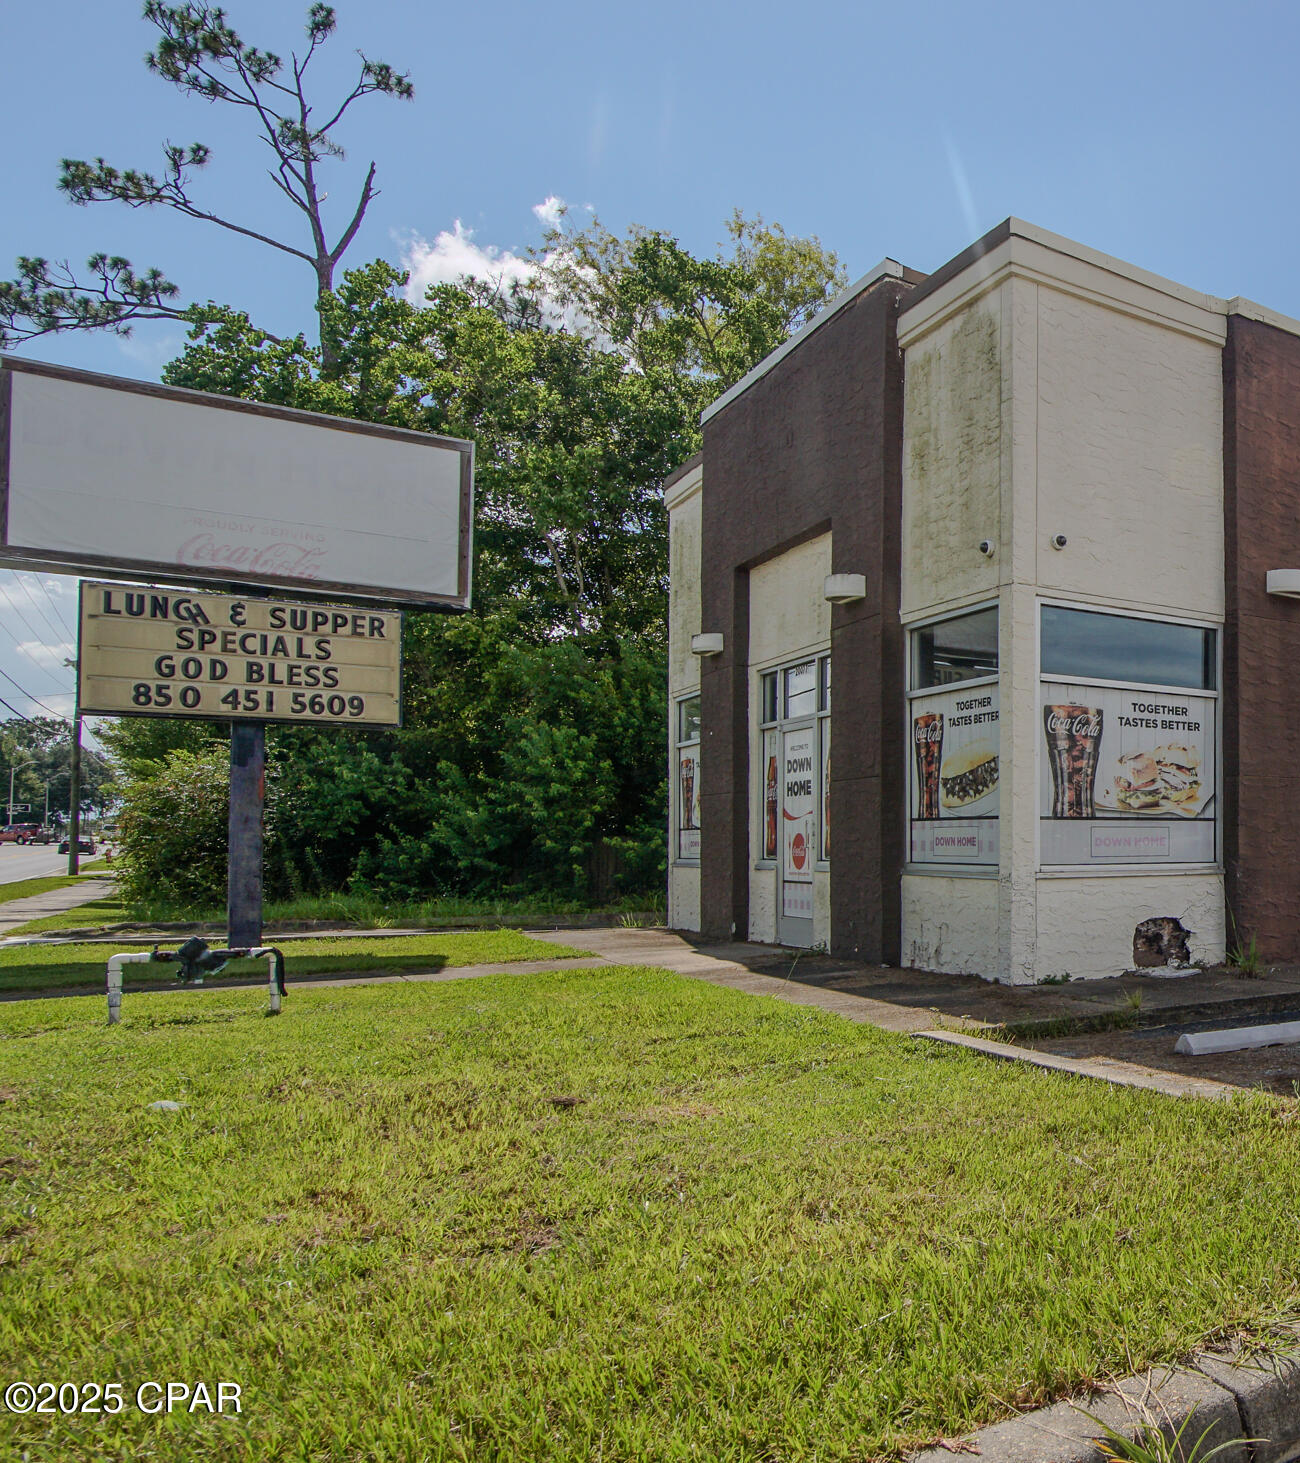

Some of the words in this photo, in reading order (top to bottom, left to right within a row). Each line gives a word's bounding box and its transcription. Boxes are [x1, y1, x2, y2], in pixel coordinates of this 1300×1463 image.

[269, 606, 386, 638] SUPPER
[175, 626, 332, 661] SPECIALS
[154, 654, 229, 681] GOD
[245, 661, 339, 688] BLESS
[132, 683, 201, 708] 850
[220, 688, 274, 713] 451
[290, 692, 365, 717] 5609
[956, 697, 992, 712] TOGETHER
[1131, 702, 1189, 717] TOGETHER
[948, 714, 973, 728] TASTES
[974, 710, 1000, 725] BETTER
[1118, 716, 1159, 729] TASTES
[1160, 719, 1201, 732] BETTER
[786, 756, 812, 775] DOWN
[786, 779, 812, 798] HOME
[935, 836, 956, 848] DOWN
[957, 836, 977, 847] HOME
[1094, 836, 1131, 848] DOWN
[1134, 835, 1167, 848] HOME
